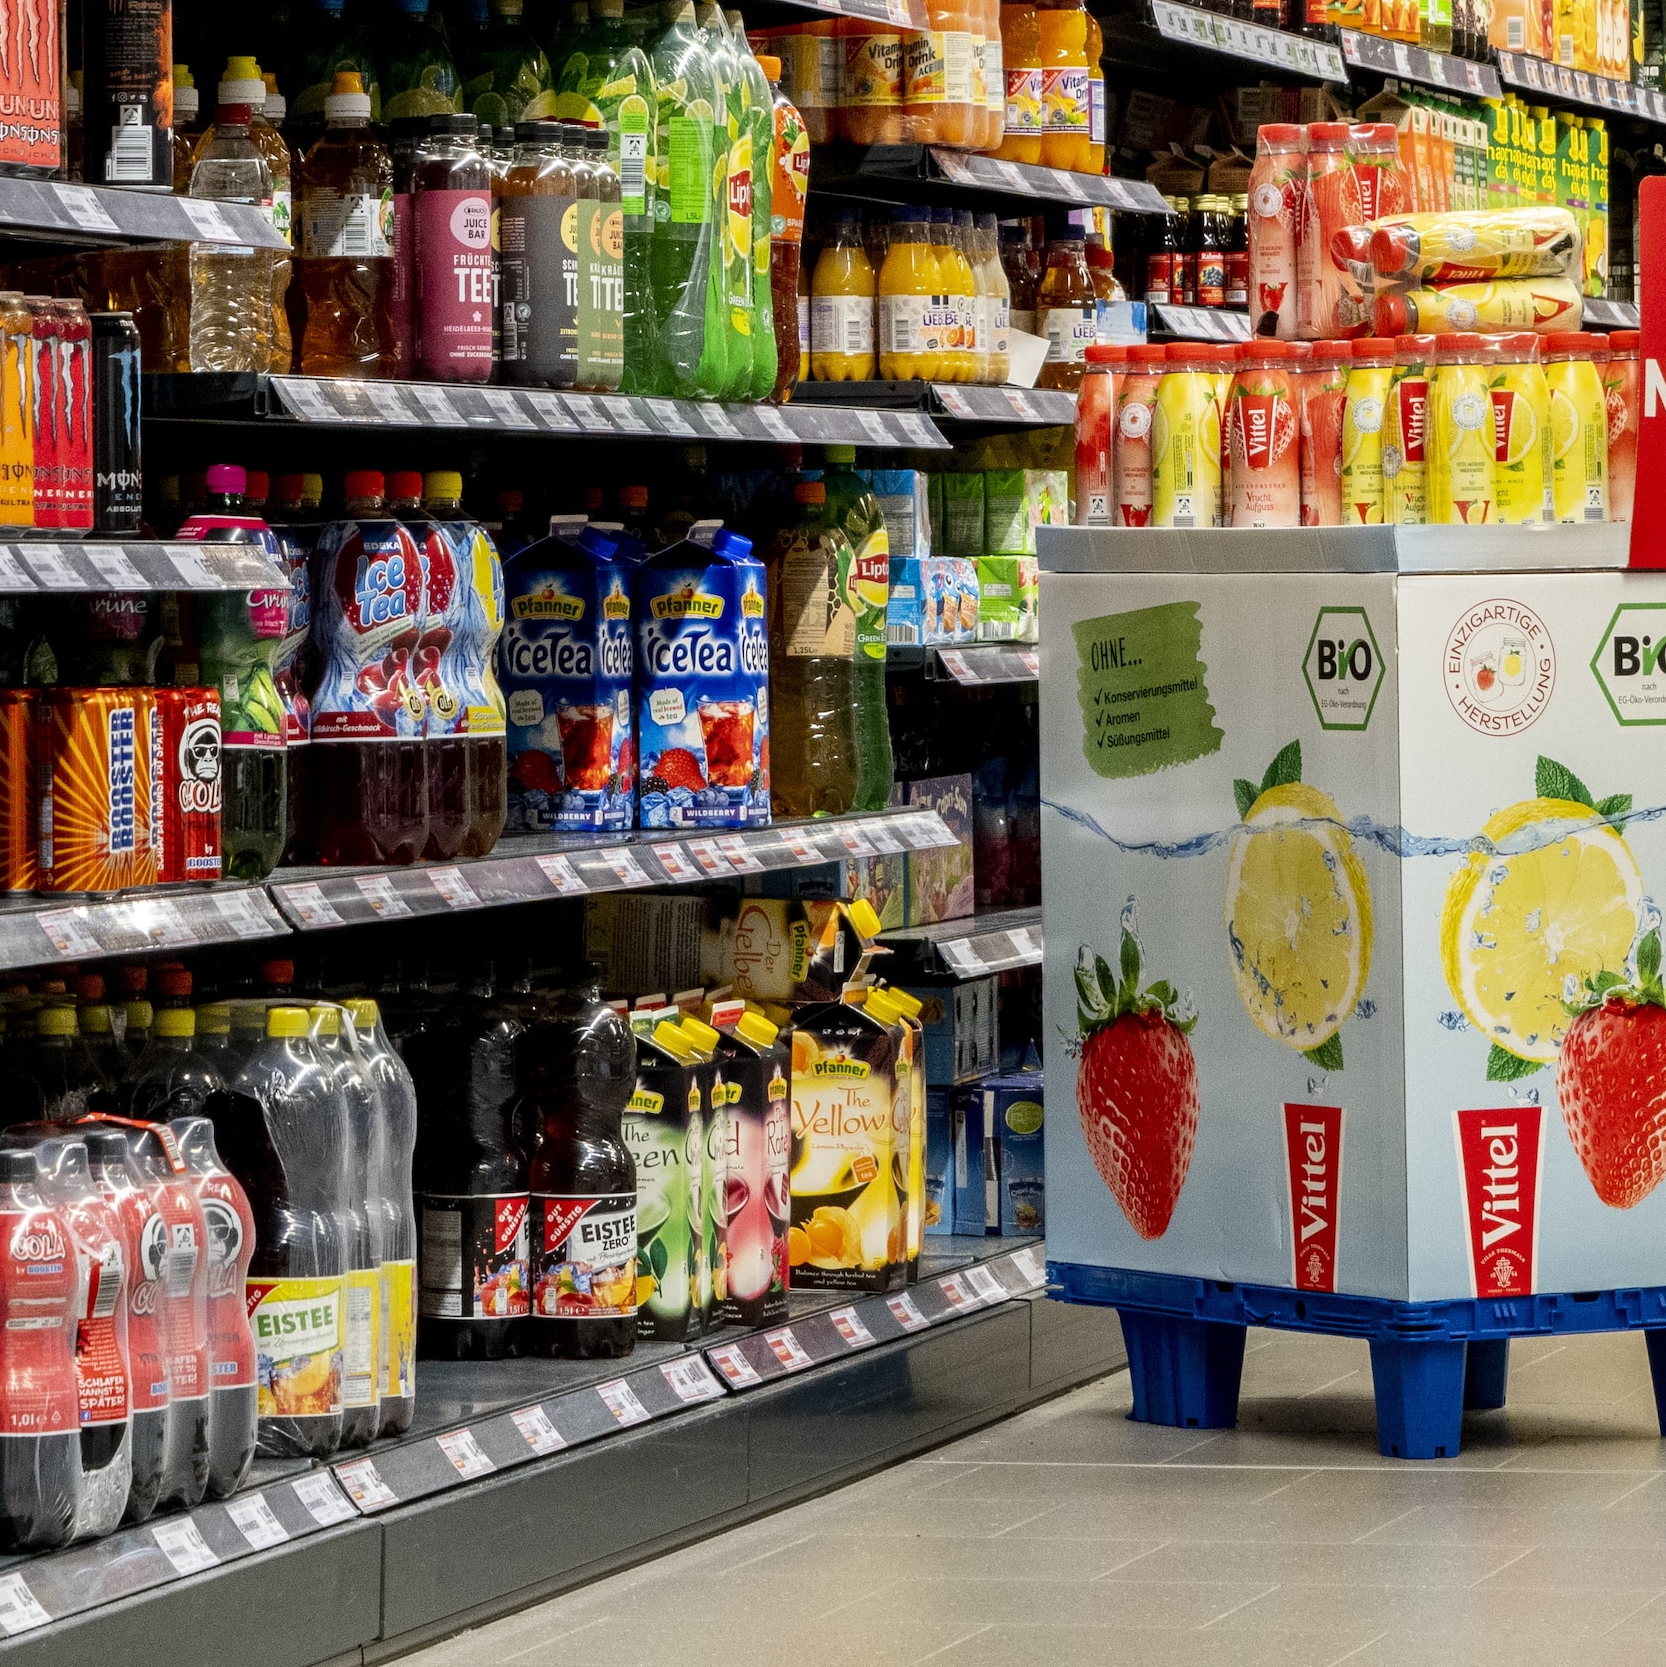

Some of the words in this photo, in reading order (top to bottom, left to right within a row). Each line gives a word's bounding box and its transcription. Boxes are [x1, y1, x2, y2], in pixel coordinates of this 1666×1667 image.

[908, 47, 937, 68] Drink
[918, 64, 934, 78] ACE
[464, 218, 487, 229] JUICE
[468, 229, 486, 239] BAR
[454, 268, 491, 303] TEE
[1248, 407, 1267, 456] Vittel
[1409, 396, 1426, 450] Vittel
[363, 540, 400, 551] EDEKA
[356, 553, 405, 594] Ice
[355, 592, 406, 627] Tea
[1448, 604, 1542, 674] EINZIGARTIGE
[1091, 637, 1143, 672] OHNE...
[1104, 677, 1198, 706] Konservierungsmittel
[1337, 686, 1351, 696] nach
[1458, 657, 1552, 731] HERSTELLUNG
[1641, 682, 1658, 692] nach
[1321, 698, 1367, 712] EG-Öko-Verordnung
[1106, 710, 1141, 727] Aromen
[1107, 728, 1171, 749] Süßungsmittel
[119, 708, 134, 853] BOOSTER
[542, 811, 592, 821] WILDBERRY
[687, 808, 736, 818] WILDBERRY
[844, 1087, 871, 1109] The
[793, 1098, 886, 1140] Yellow
[1299, 1121, 1329, 1244] Vittel
[1480, 1122, 1523, 1251] Vittel
[499, 1201, 515, 1223] GUT
[547, 1201, 563, 1223] GUT
[501, 1202, 526, 1245] GÜNSTIG
[549, 1203, 583, 1245] GÜNSTIG
[581, 1213, 636, 1245] EISTEE
[10, 1221, 67, 1262] COLA
[27, 1263, 64, 1274] BOOSTER
[795, 1268, 820, 1278] Balance
[821, 1269, 844, 1279] through
[844, 1269, 867, 1279] herbal
[257, 1304, 334, 1339] EISTEE
[78, 1376, 125, 1390] SCHLAFEN
[79, 1385, 112, 1398] KANNST
[80, 1395, 125, 1411] SPÄTER!
